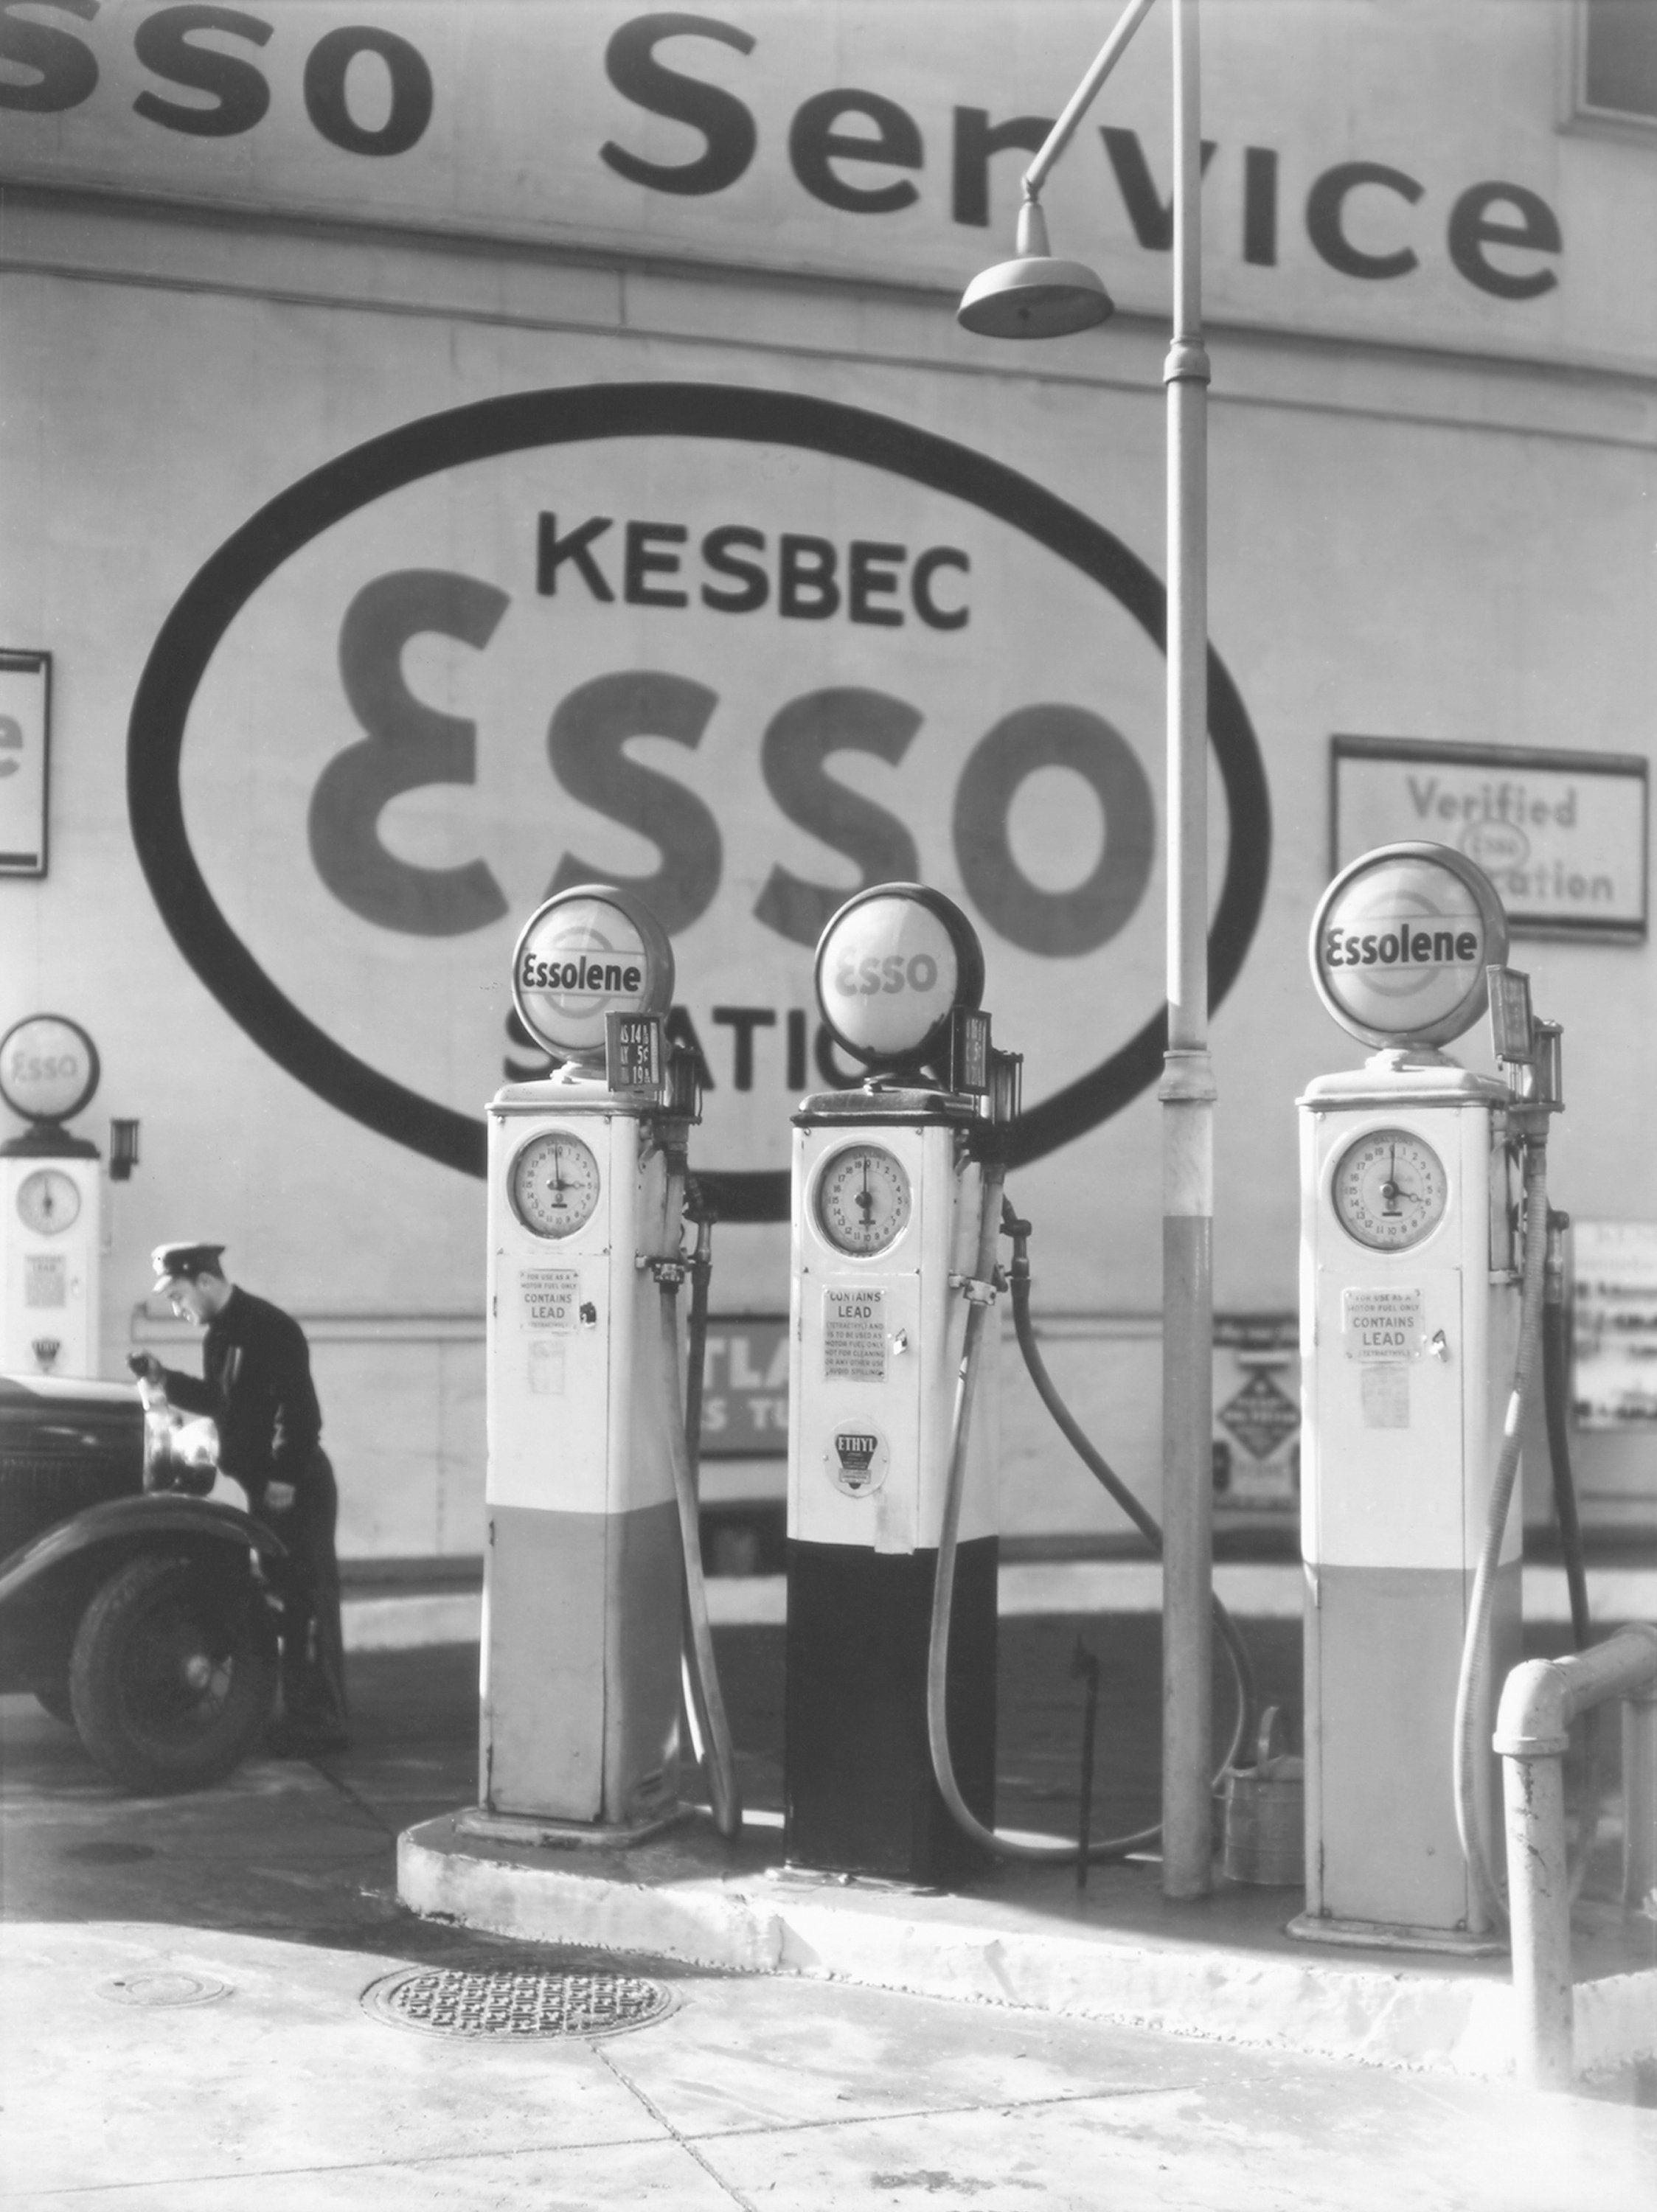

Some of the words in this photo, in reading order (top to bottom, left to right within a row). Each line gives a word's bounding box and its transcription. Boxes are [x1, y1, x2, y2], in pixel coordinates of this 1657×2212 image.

[598, 12, 1562, 299] Service
[536, 510, 971, 632] KESBEC
[1406, 774, 1578, 829] Verified
[1325, 923, 1478, 967] Essolene
[522, 953, 641, 992] Essolene
[524, 1293, 572, 1304] CONTAINS
[830, 1292, 881, 1302] CONTAINS
[532, 1307, 566, 1318] LEAD
[838, 1305, 872, 1318] LEAD
[1352, 1316, 1414, 1328] CONTAINS
[1363, 1332, 1405, 1346] LEAD
[838, 1436, 873, 1453] ETHYL
